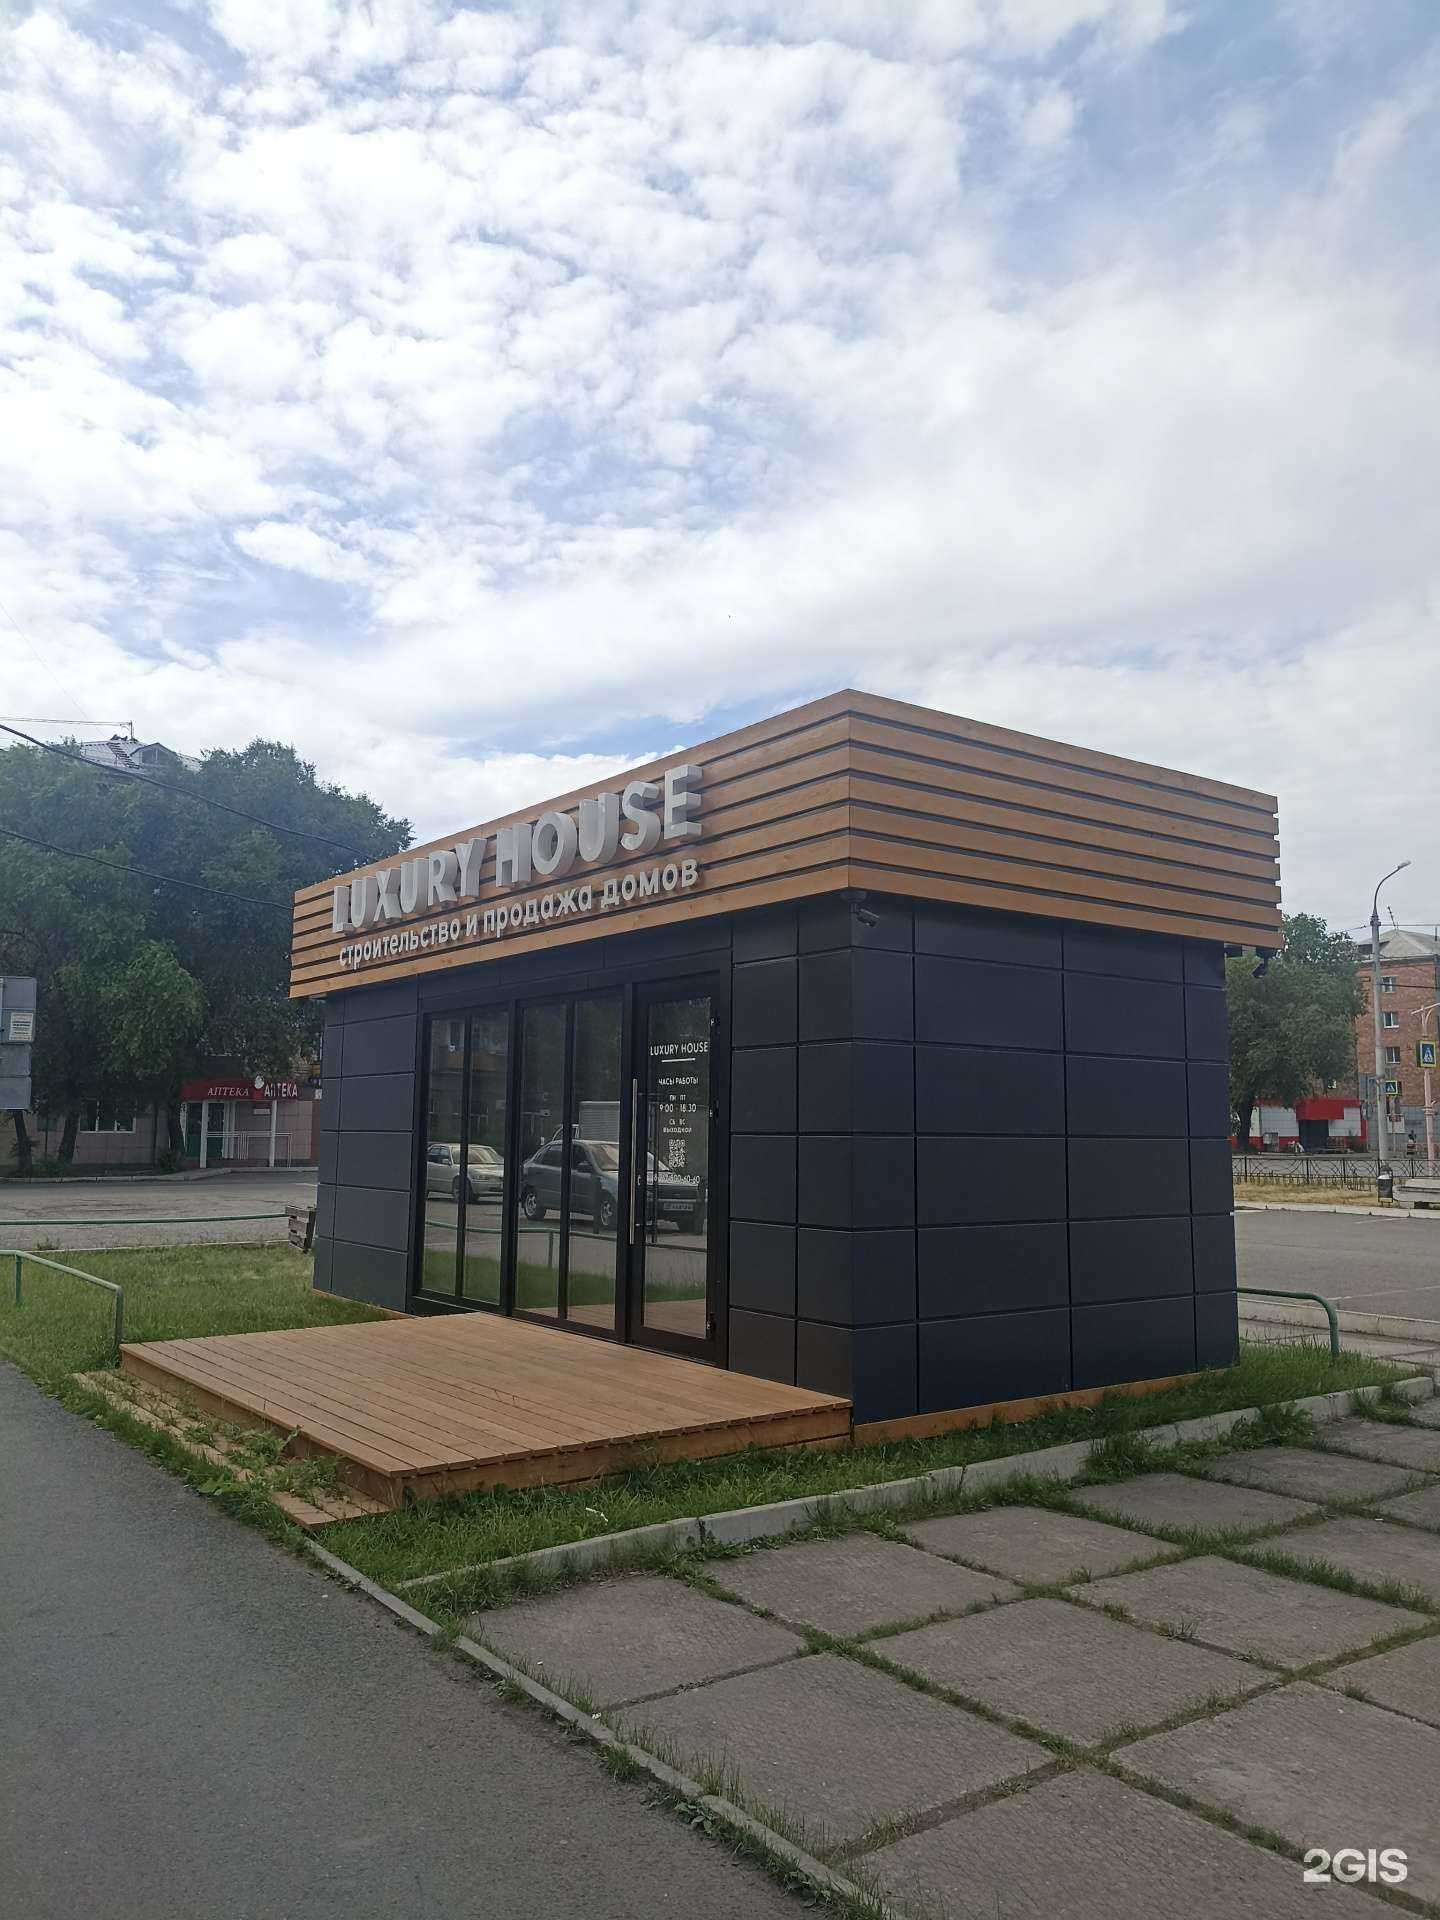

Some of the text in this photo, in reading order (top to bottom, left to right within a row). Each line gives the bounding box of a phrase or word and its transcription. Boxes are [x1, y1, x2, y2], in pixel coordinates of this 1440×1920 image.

[332, 763, 703, 933] LUXURY HOUSE
[339, 858, 700, 969] строительство и продажа домов
[650, 1041, 709, 1056] LUXURY HOUSE
[658, 1076, 699, 1086] ЧАСЫ РАБОТЫ
[207, 1087, 249, 1097] АПТЕКА
[264, 1082, 298, 1098] АПТЕКА
